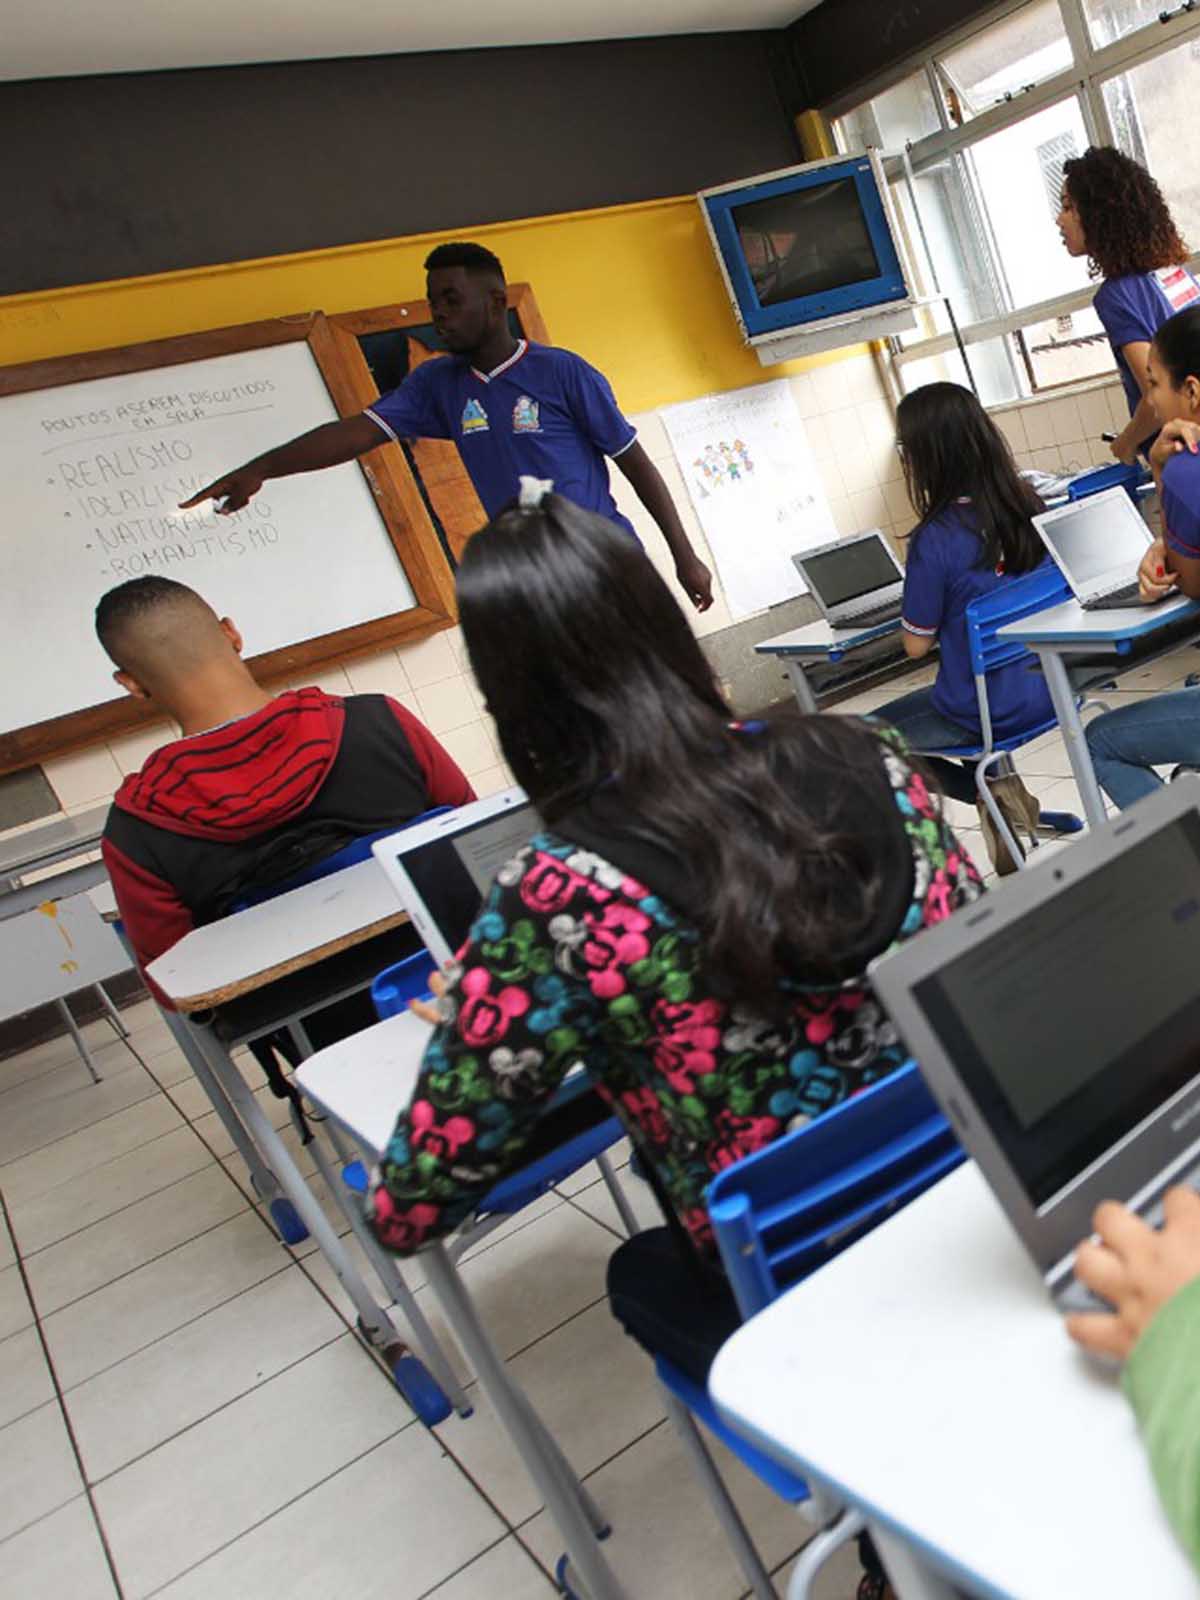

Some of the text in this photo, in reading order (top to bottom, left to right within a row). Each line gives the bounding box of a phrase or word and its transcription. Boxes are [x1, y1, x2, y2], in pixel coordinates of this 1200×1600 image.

[188, 379, 276, 406] DISCUTIDOS
[58, 439, 193, 490] REALISMO
[110, 522, 279, 578] ROMANTISMO
